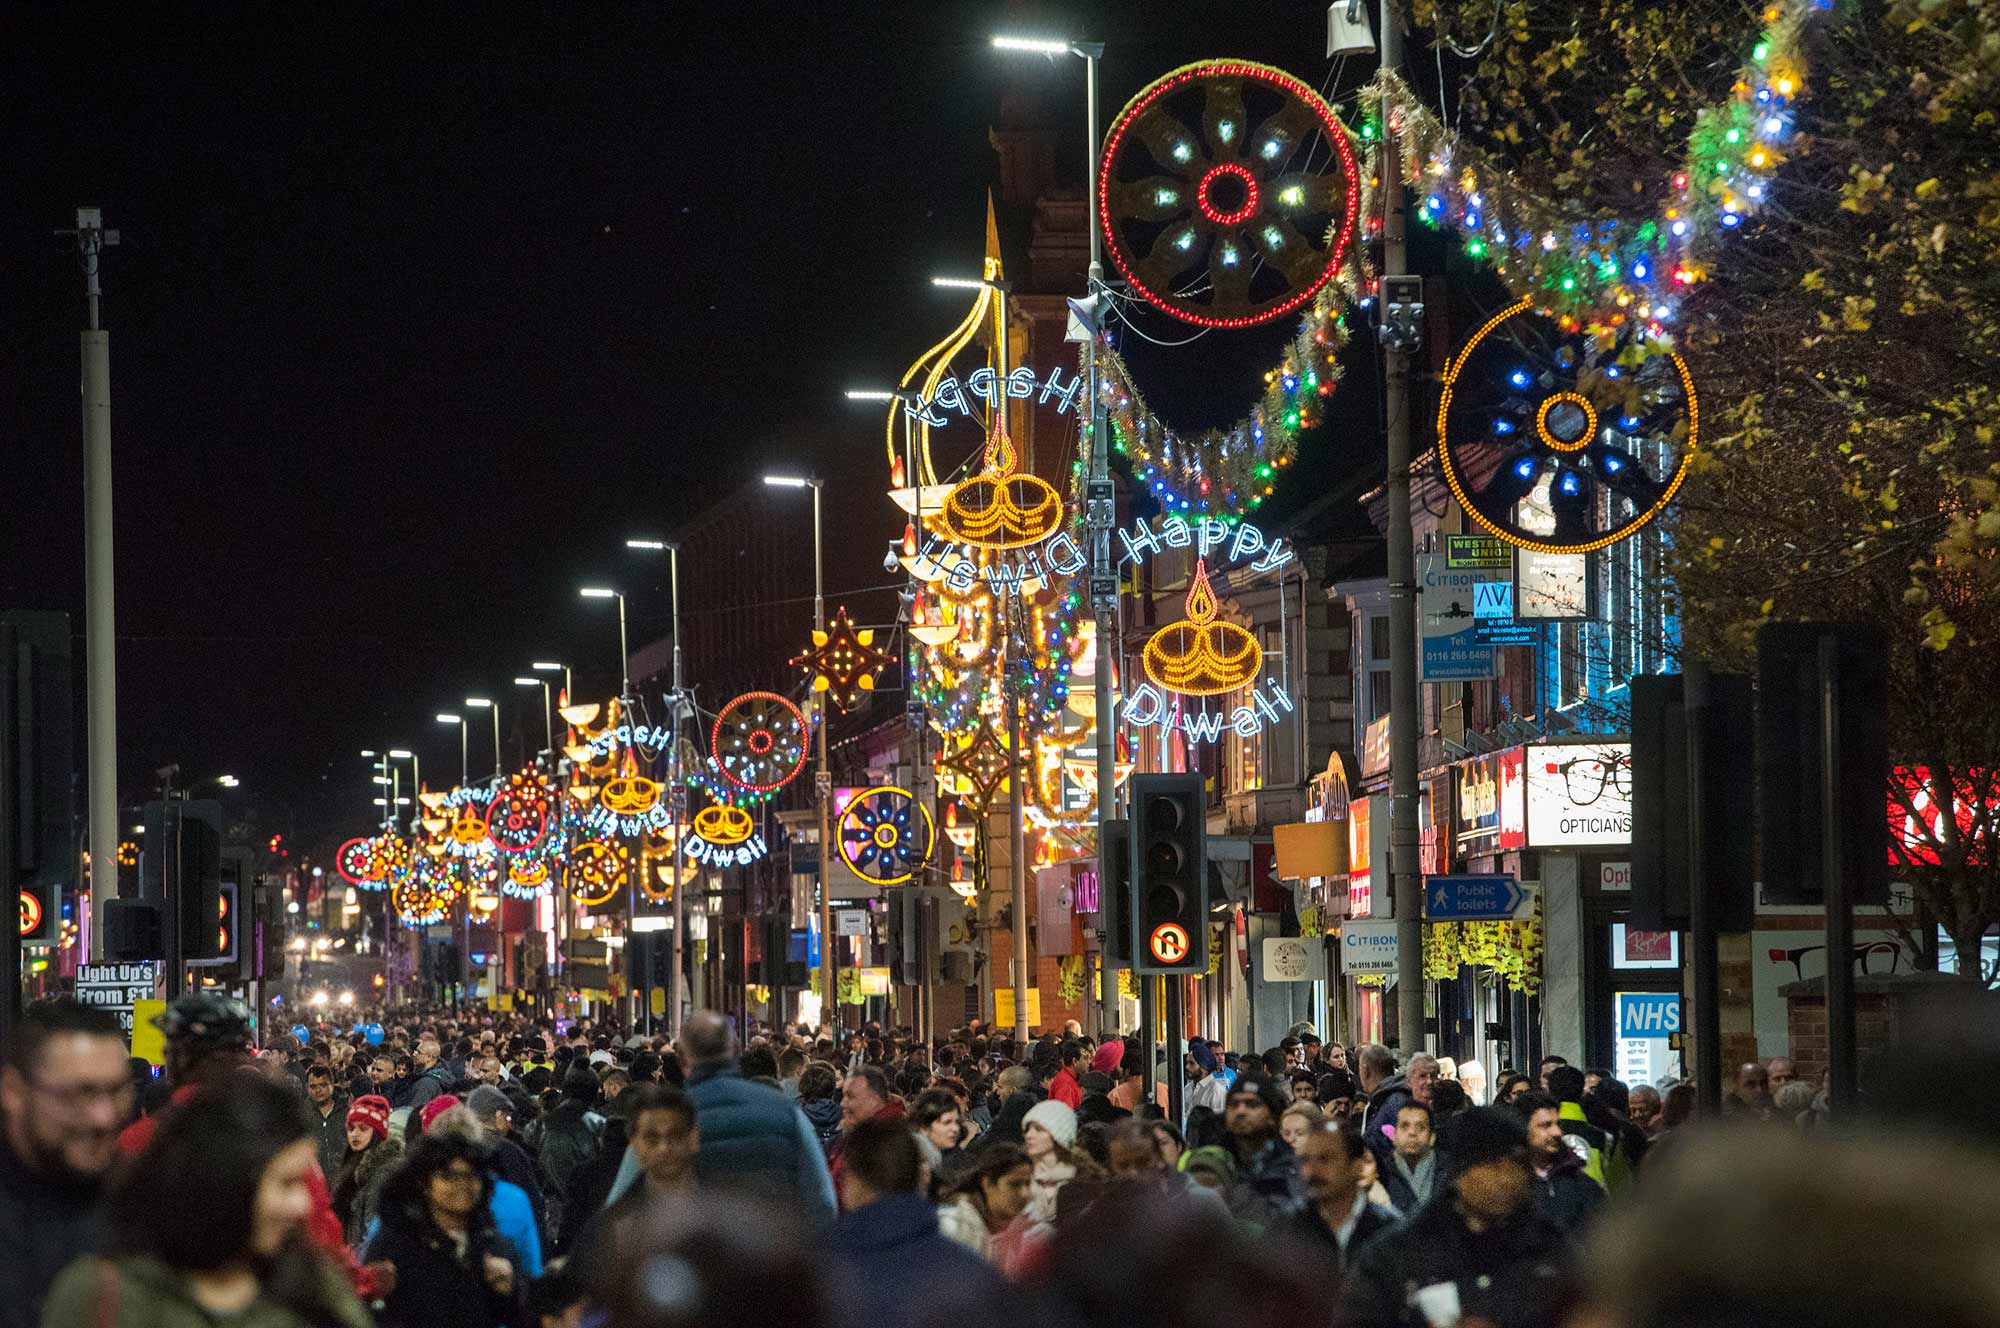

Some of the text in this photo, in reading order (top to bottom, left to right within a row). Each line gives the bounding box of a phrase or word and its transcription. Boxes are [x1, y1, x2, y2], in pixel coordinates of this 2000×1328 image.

[1118, 517, 1293, 572] Happy
[1453, 540, 1512, 549] WESTERN
[1471, 549, 1512, 558] UNION
[1121, 677, 1293, 743] Diwali
[1560, 818, 1632, 834] OPTICIANS
[683, 834, 768, 868] Diwali
[1602, 866, 1632, 887] Opt
[1456, 885, 1496, 896] Public
[1456, 898, 1497, 910] toilets
[1346, 933, 1398, 947] CITIBON
[77, 964, 153, 983] Light Up's
[77, 988, 123, 1005] From
[1625, 1002, 1680, 1031] NHS
